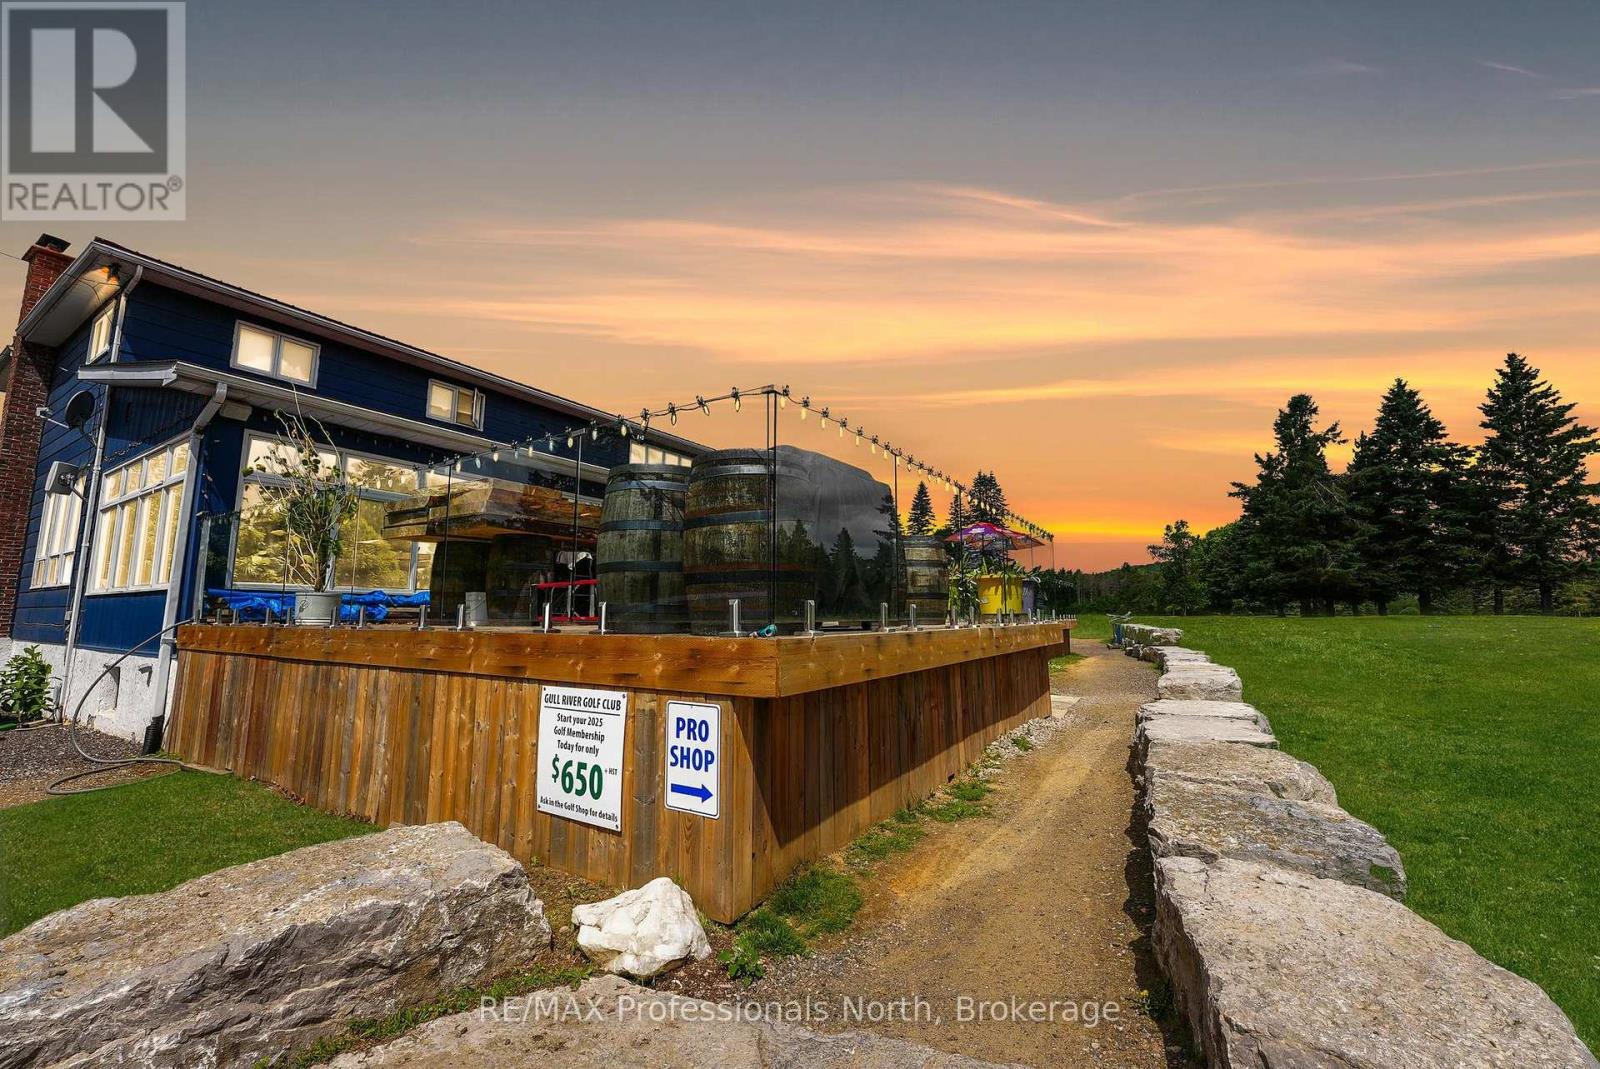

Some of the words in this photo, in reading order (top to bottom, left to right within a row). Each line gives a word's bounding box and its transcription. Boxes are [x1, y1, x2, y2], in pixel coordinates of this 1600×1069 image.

[544, 693, 560, 705] GULL
[561, 695, 582, 707] RIVER
[583, 697, 601, 709] GOLF
[602, 699, 621, 711] CLUB
[557, 713, 572, 723] Start
[573, 716, 587, 726] your
[587, 717, 603, 727] 2025
[676, 717, 709, 742] PRO
[554, 725, 566, 736] Golf
[566, 727, 605, 744] Membership
[557, 739, 574, 753] Today
[575, 742, 584, 752] for
[585, 745, 599, 757] only
[670, 745, 715, 772] SHOP
[552, 753, 603, 800] $650
[540, 795, 549, 805] Ask
[549, 798, 555, 806] in
[555, 800, 563, 809] the
[564, 802, 575, 811] Golf
[575, 805, 589, 816] Shop
[589, 808, 598, 817] for
[598, 810, 618, 823] details
